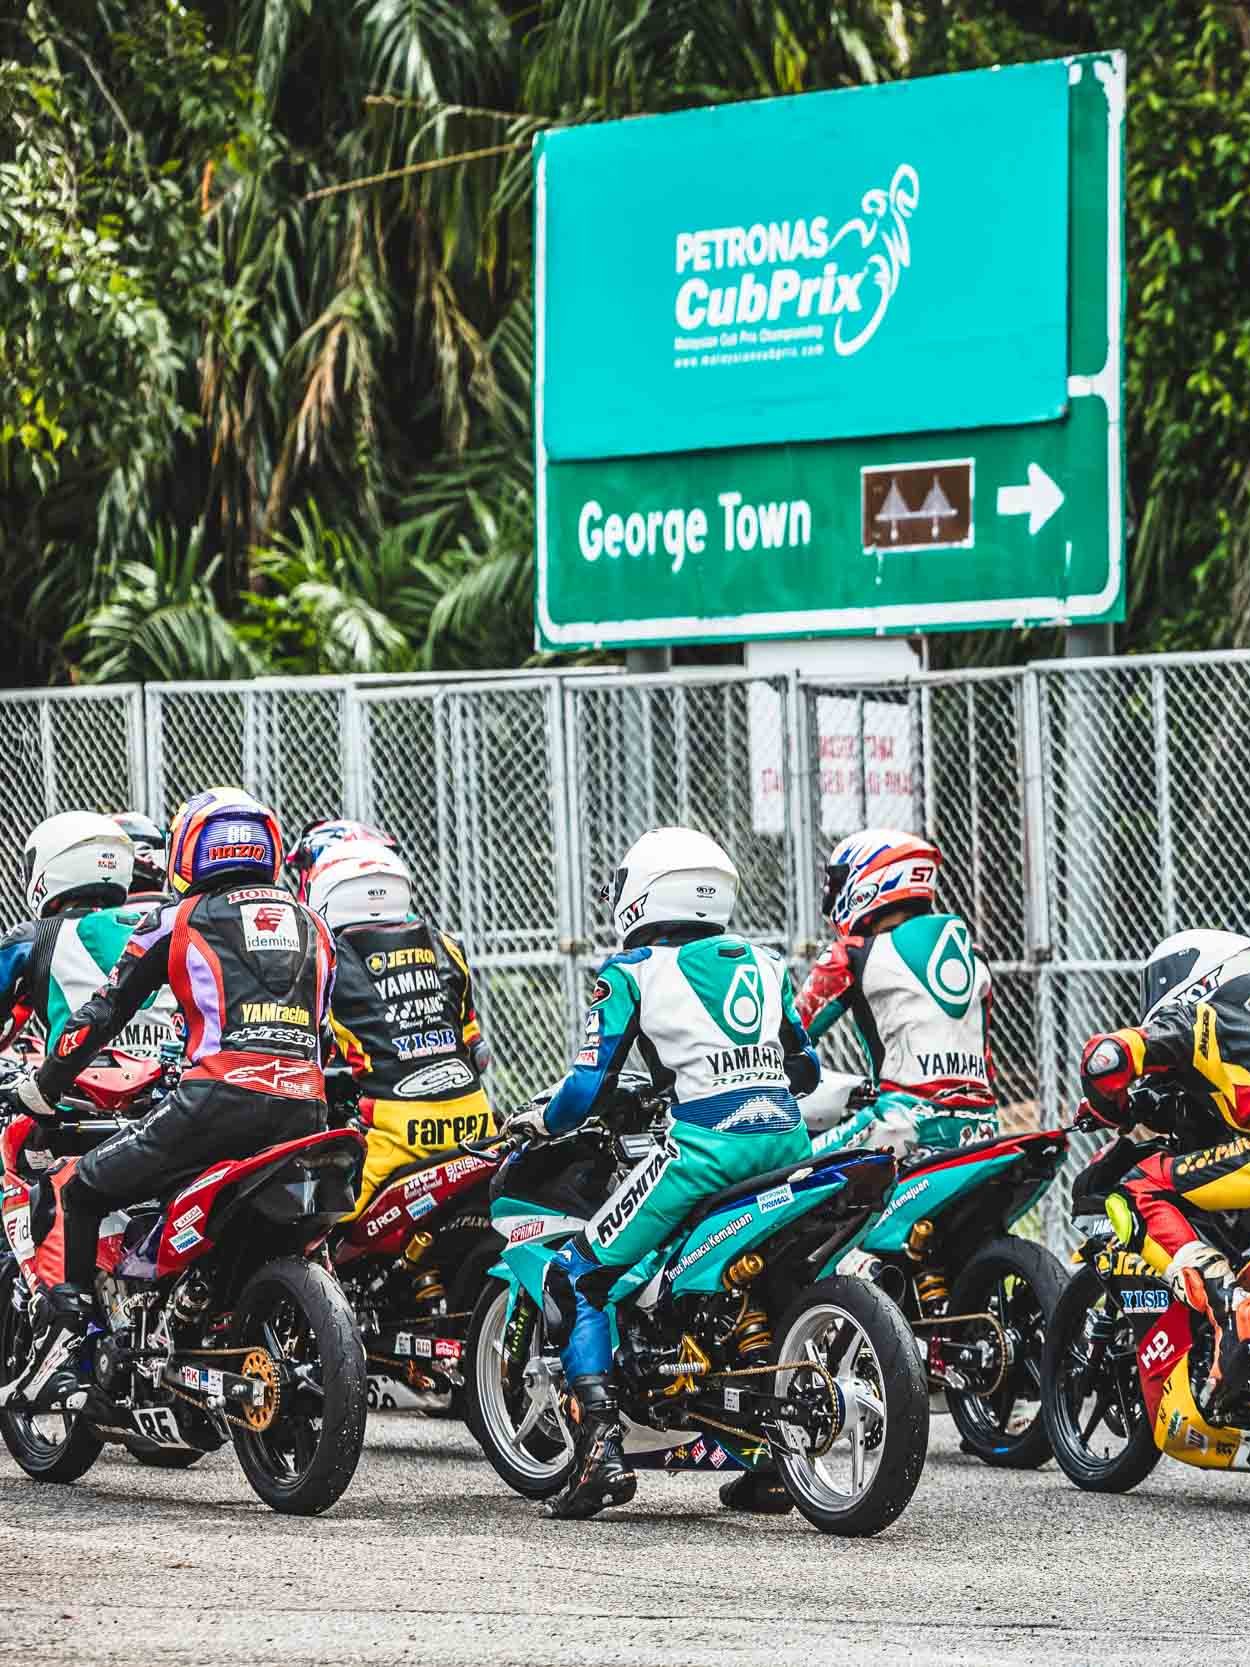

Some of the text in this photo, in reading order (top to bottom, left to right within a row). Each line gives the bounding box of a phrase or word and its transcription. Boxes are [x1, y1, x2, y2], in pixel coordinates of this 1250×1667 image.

[675, 216, 829, 274] PETRONAS
[675, 261, 864, 330] CubPrix
[578, 491, 811, 574] George Town
[227, 825, 252, 843] 86
[910, 867, 933, 883] 57
[619, 892, 648, 932] KYT
[374, 969, 441, 1000] YAMAHA
[242, 1003, 309, 1026] YAMracing
[392, 1028, 456, 1053] YISB
[706, 1047, 784, 1075] YAMAHA
[917, 1053, 985, 1079] YAMAHA
[376, 1206, 401, 1229] RCB
[511, 1223, 543, 1242] SPRINTA
[665, 1212, 753, 1282] Terus Memacu Kemajuan
[1120, 1290, 1168, 1309] YISB
[186, 1368, 198, 1383] RK
